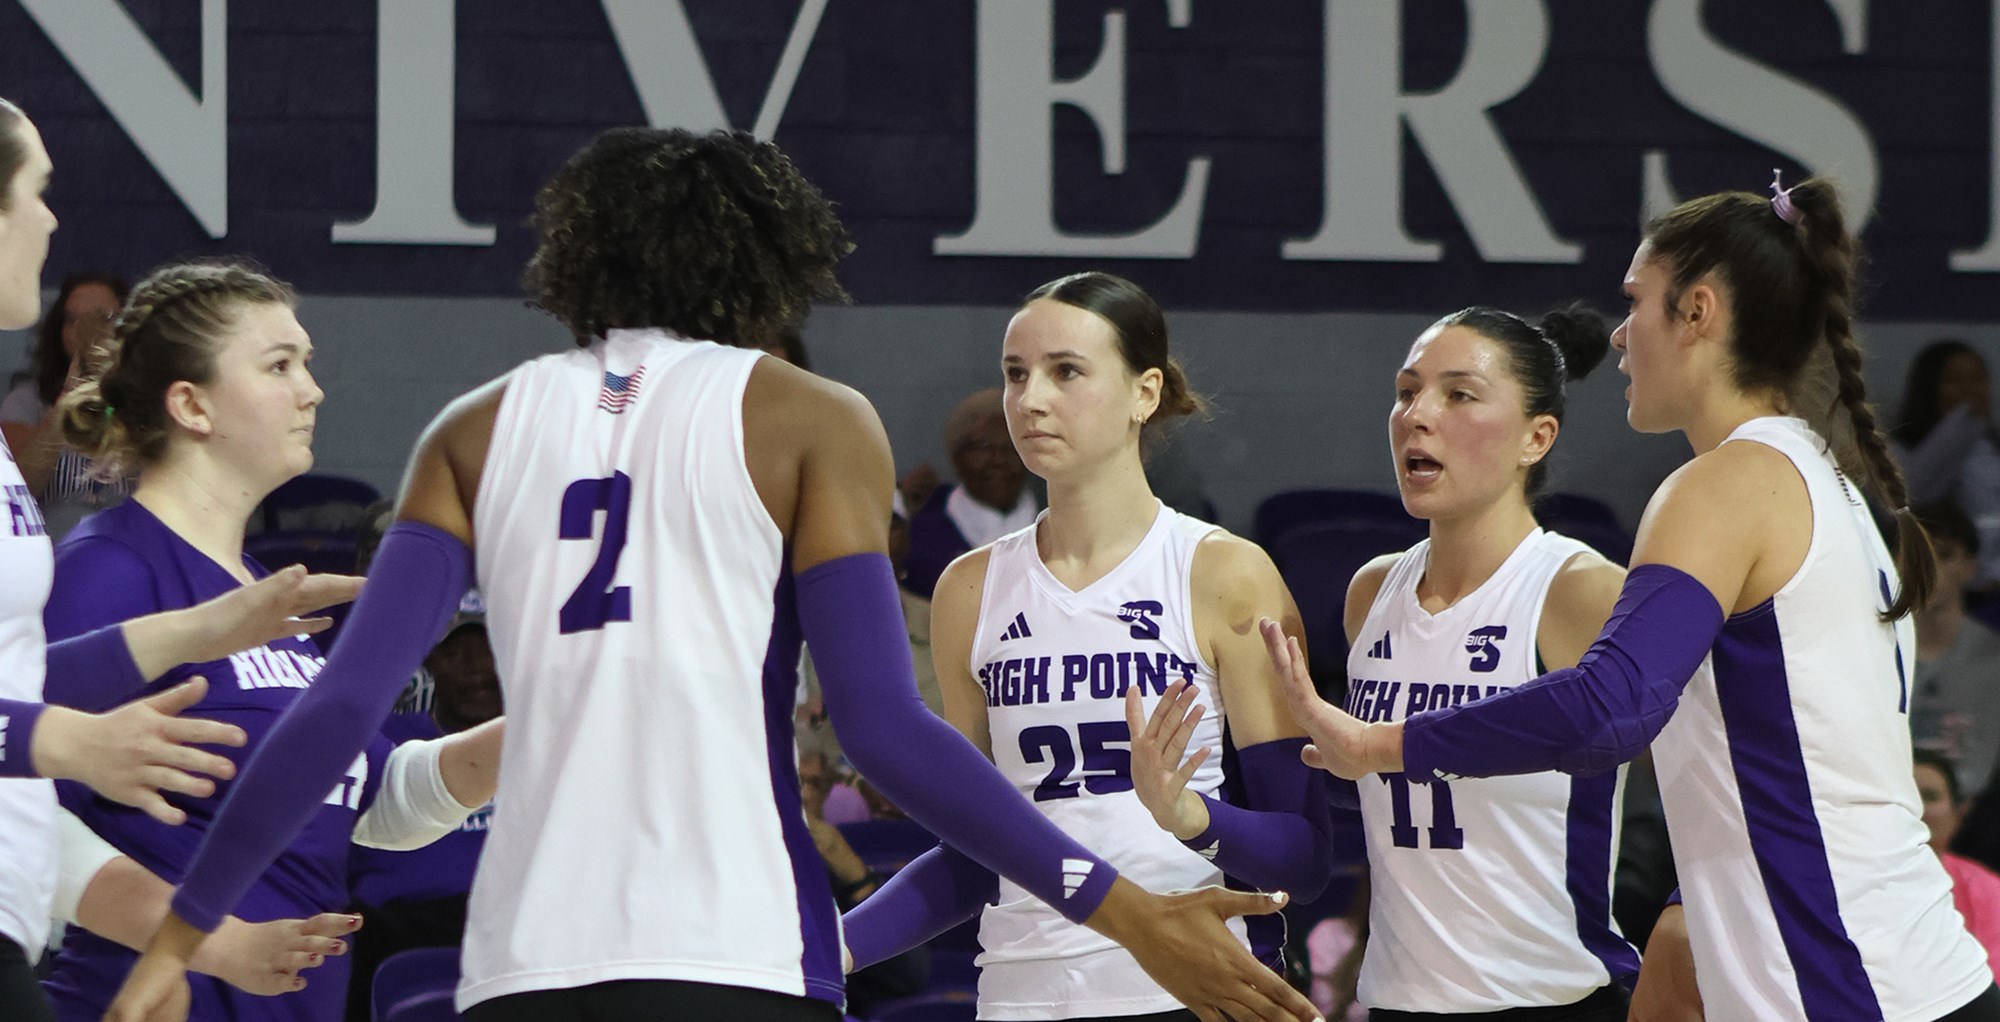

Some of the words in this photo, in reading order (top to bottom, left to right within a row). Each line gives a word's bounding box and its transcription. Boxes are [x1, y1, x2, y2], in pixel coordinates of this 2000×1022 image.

[559, 469, 632, 635] 2
[1117, 606, 1142, 619] BIG
[1061, 652, 1198, 702] POINT
[1344, 679, 1401, 724] IGH
[1405, 683, 1514, 718] POI
[1018, 720, 1135, 802] 25
[1377, 771, 1464, 850] 11
